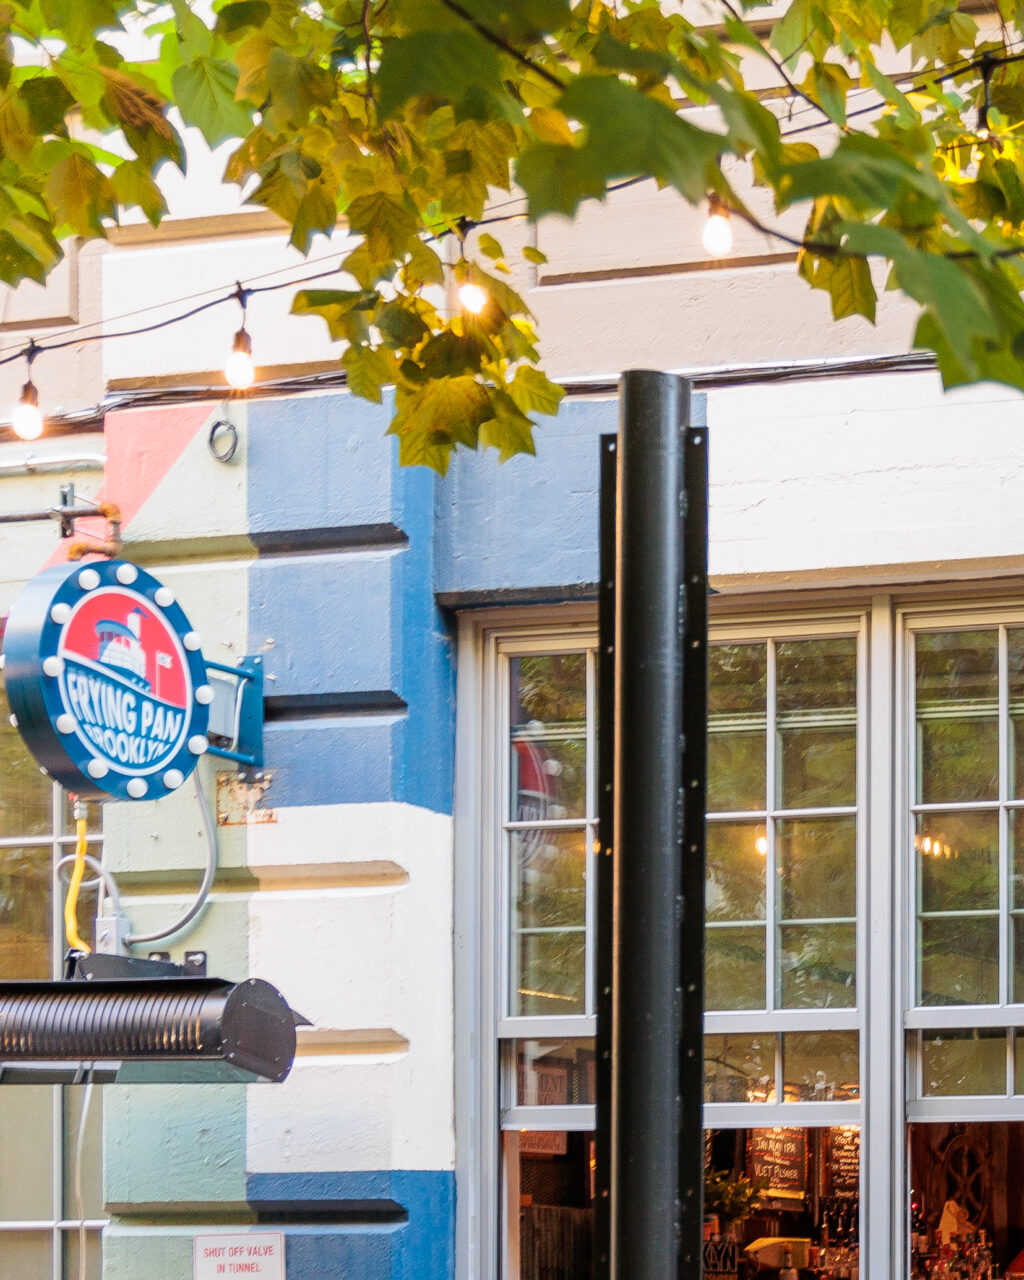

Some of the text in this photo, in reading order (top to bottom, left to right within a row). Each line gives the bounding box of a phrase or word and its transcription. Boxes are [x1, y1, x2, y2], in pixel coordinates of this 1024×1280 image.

[66, 670, 183, 743] FRYING PAN
[82, 722, 172, 765] BROOKLYN
[203, 1245, 274, 1258] SHUT OFF VALVE
[216, 1262, 261, 1274] IN TUNNEL
